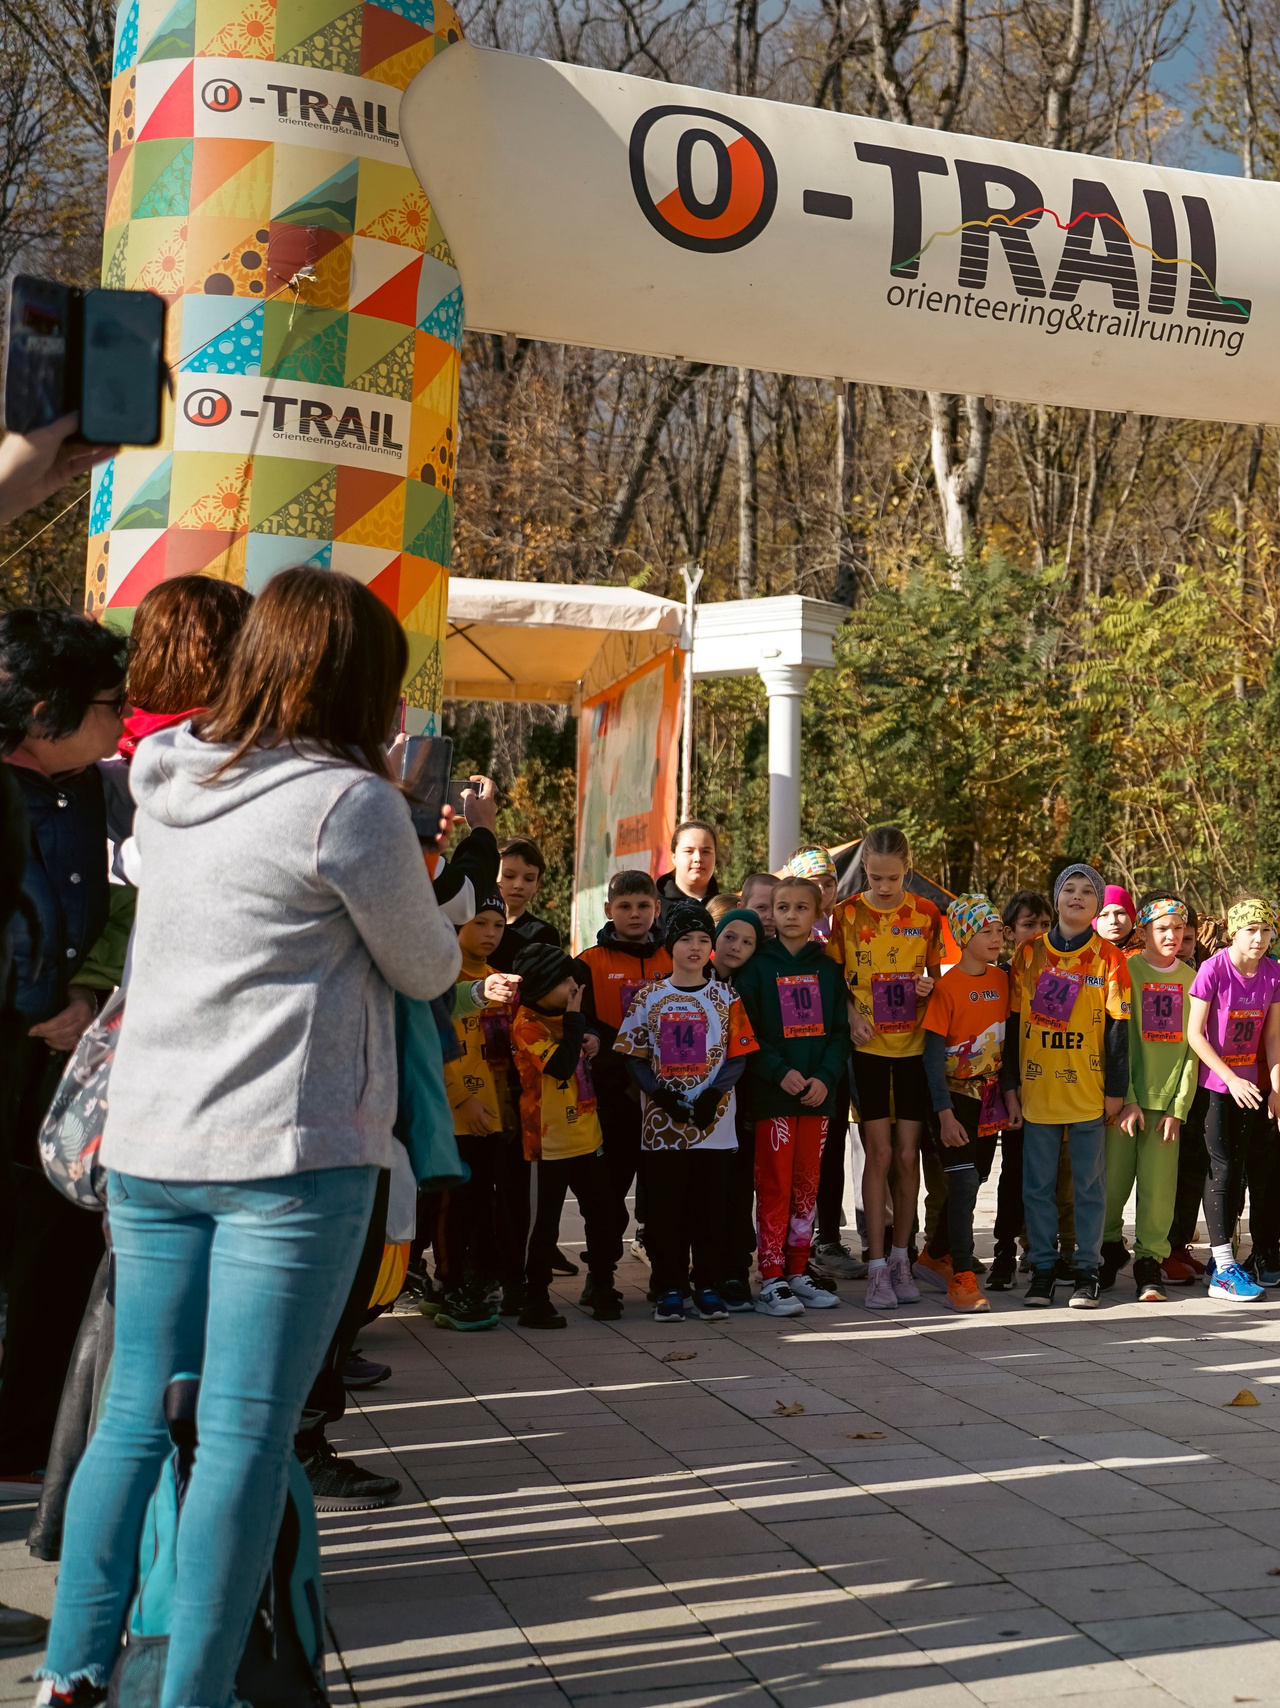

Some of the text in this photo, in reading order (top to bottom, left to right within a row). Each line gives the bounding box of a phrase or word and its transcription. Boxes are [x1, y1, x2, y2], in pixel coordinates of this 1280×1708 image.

[278, 117, 399, 147] orienteering&trailrunning
[628, 105, 1252, 325] O-TRAIL
[887, 283, 1245, 357] orienteering&trailrunning
[273, 432, 402, 460] orienteering&trailrunning
[790, 987, 812, 1010] 10
[884, 983, 905, 1008] 19
[1043, 979, 1071, 1005] 24
[1153, 995, 1173, 1017] 13
[673, 1025, 695, 1048] 14
[1041, 1031, 1084, 1050] ГДЕ?
[1232, 1021, 1255, 1042] 28
